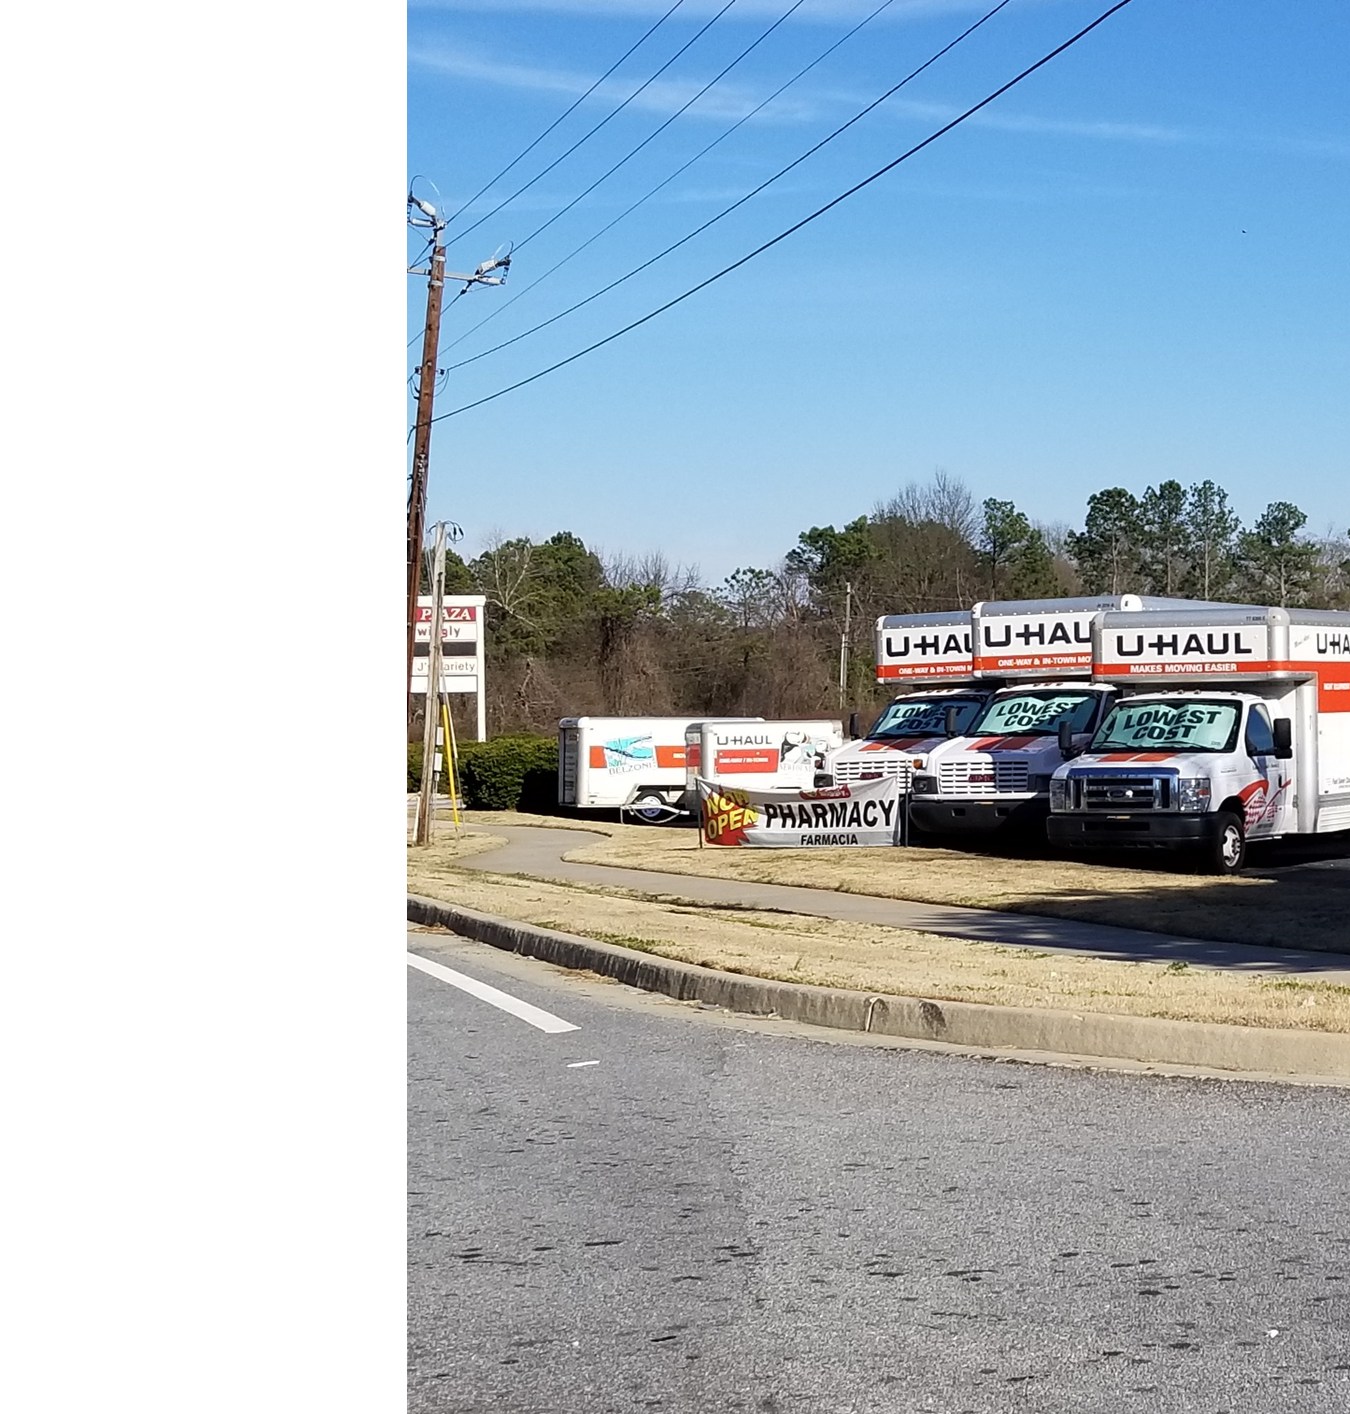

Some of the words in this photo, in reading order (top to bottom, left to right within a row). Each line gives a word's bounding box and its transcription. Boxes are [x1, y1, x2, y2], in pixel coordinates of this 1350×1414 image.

[420, 608, 471, 620] PAZA
[417, 626, 461, 638] wigly
[1117, 633, 1252, 656] U-HAUL
[442, 662, 475, 672] ariety
[998, 658, 1033, 667] ONE-WAY
[1033, 657, 1040, 665] &
[1042, 656, 1076, 665] IN-TOWN
[899, 666, 929, 674] ONE-WAY
[929, 665, 936, 674] &
[936, 665, 967, 673] IN-TOWN
[1130, 664, 1162, 674] MAKES
[1165, 664, 1203, 673] MOVING
[1204, 663, 1237, 672] EASIER
[996, 701, 1083, 718] LOWEST
[896, 717, 945, 730] COST
[1004, 714, 1061, 727] COST
[1124, 709, 1221, 730] LOWEST
[1132, 725, 1196, 740] COST
[717, 735, 772, 745] U-HAUL
[706, 790, 750, 817] NOW
[764, 800, 895, 829] PHARMACY
[707, 806, 760, 839] OPEN
[801, 834, 858, 846] FARMACIA
